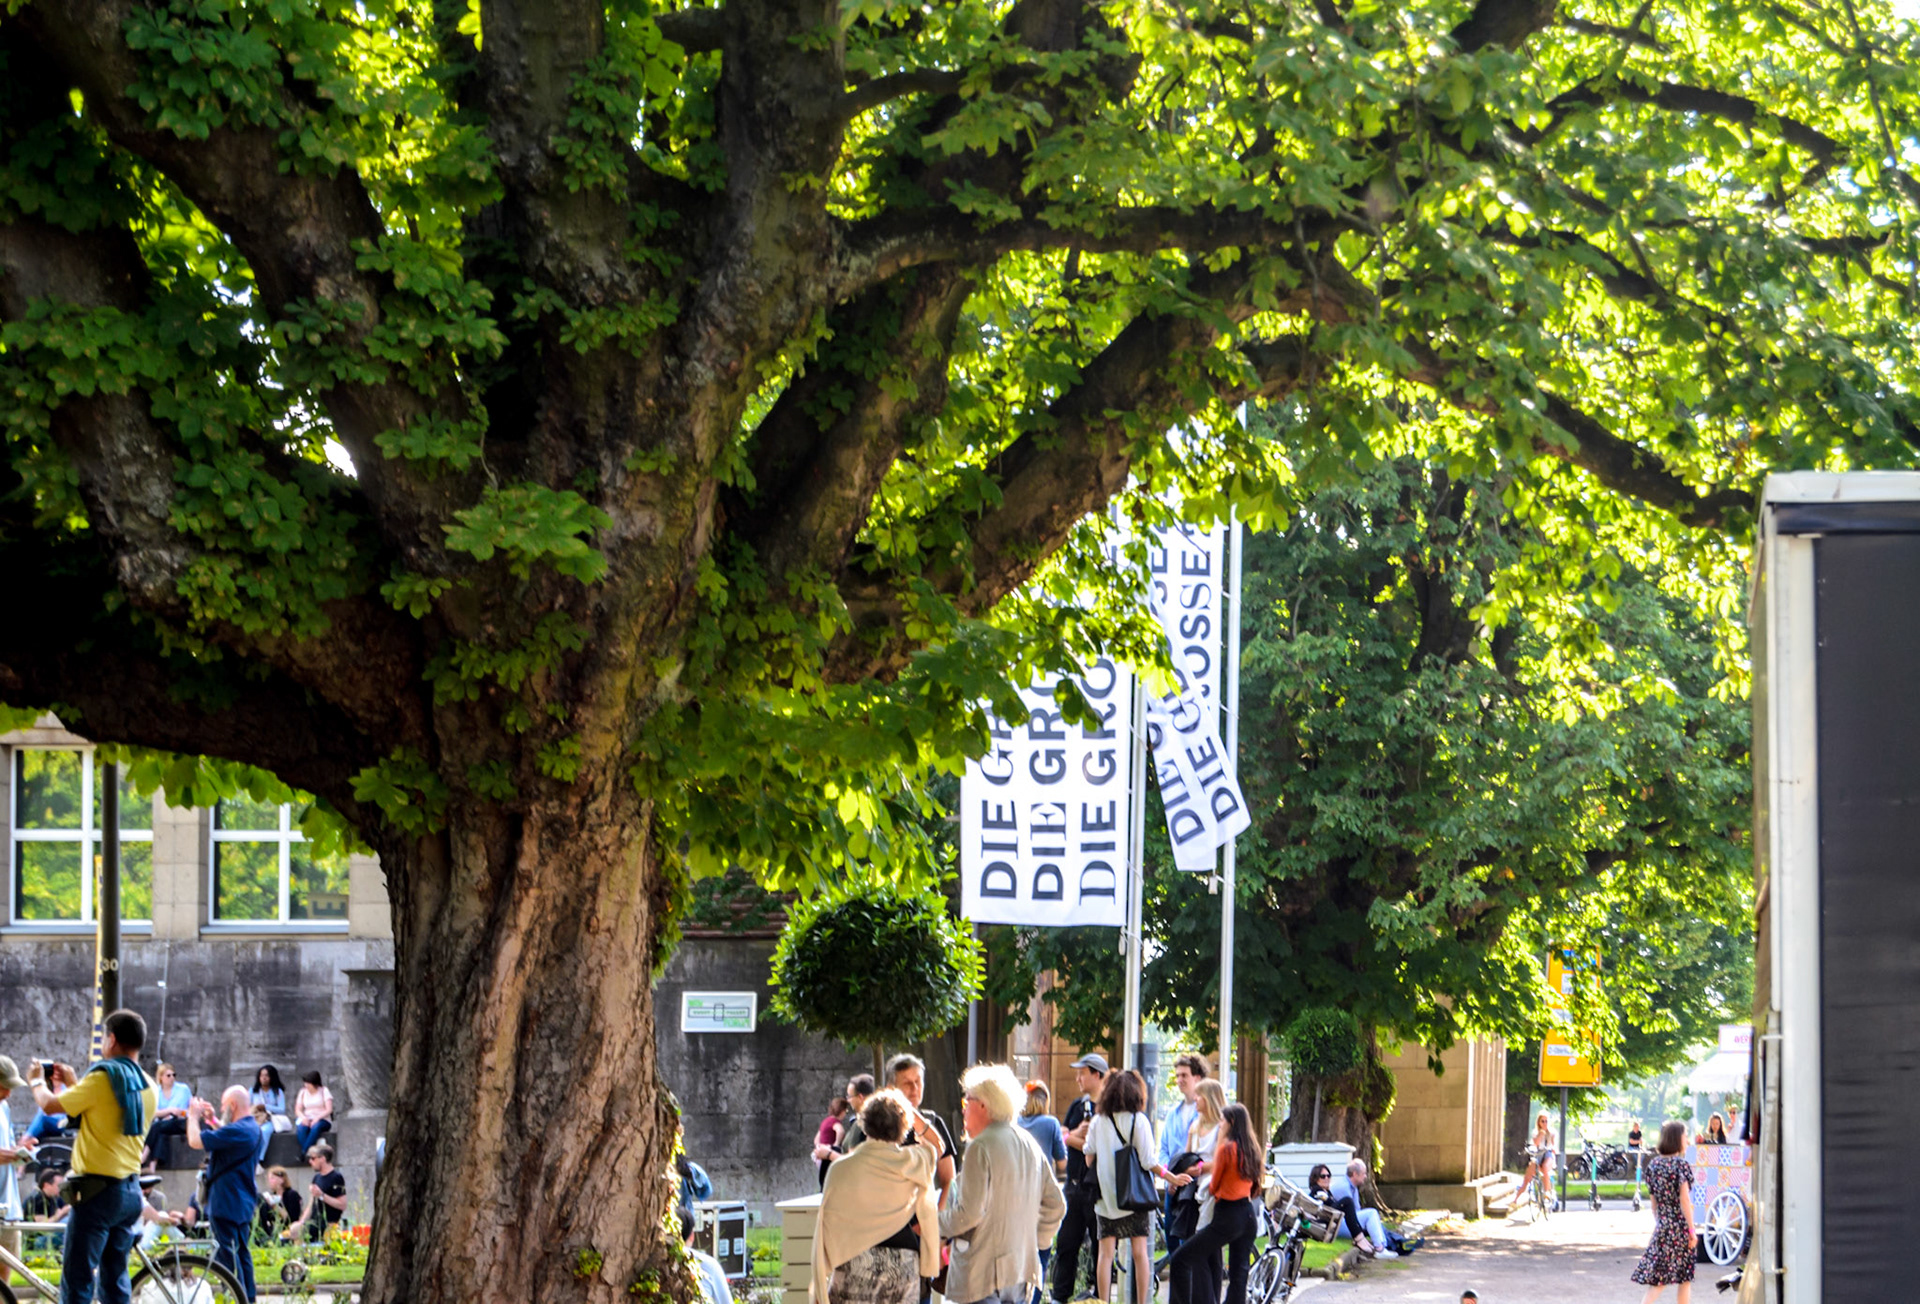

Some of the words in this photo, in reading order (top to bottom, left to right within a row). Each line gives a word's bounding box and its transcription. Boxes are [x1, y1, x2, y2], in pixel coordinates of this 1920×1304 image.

[1157, 759, 1206, 847] DIE
[1186, 736, 1240, 824] DIE
[980, 800, 1018, 899] DIE
[1030, 803, 1066, 901] DIE
[1079, 800, 1116, 906] DIE
